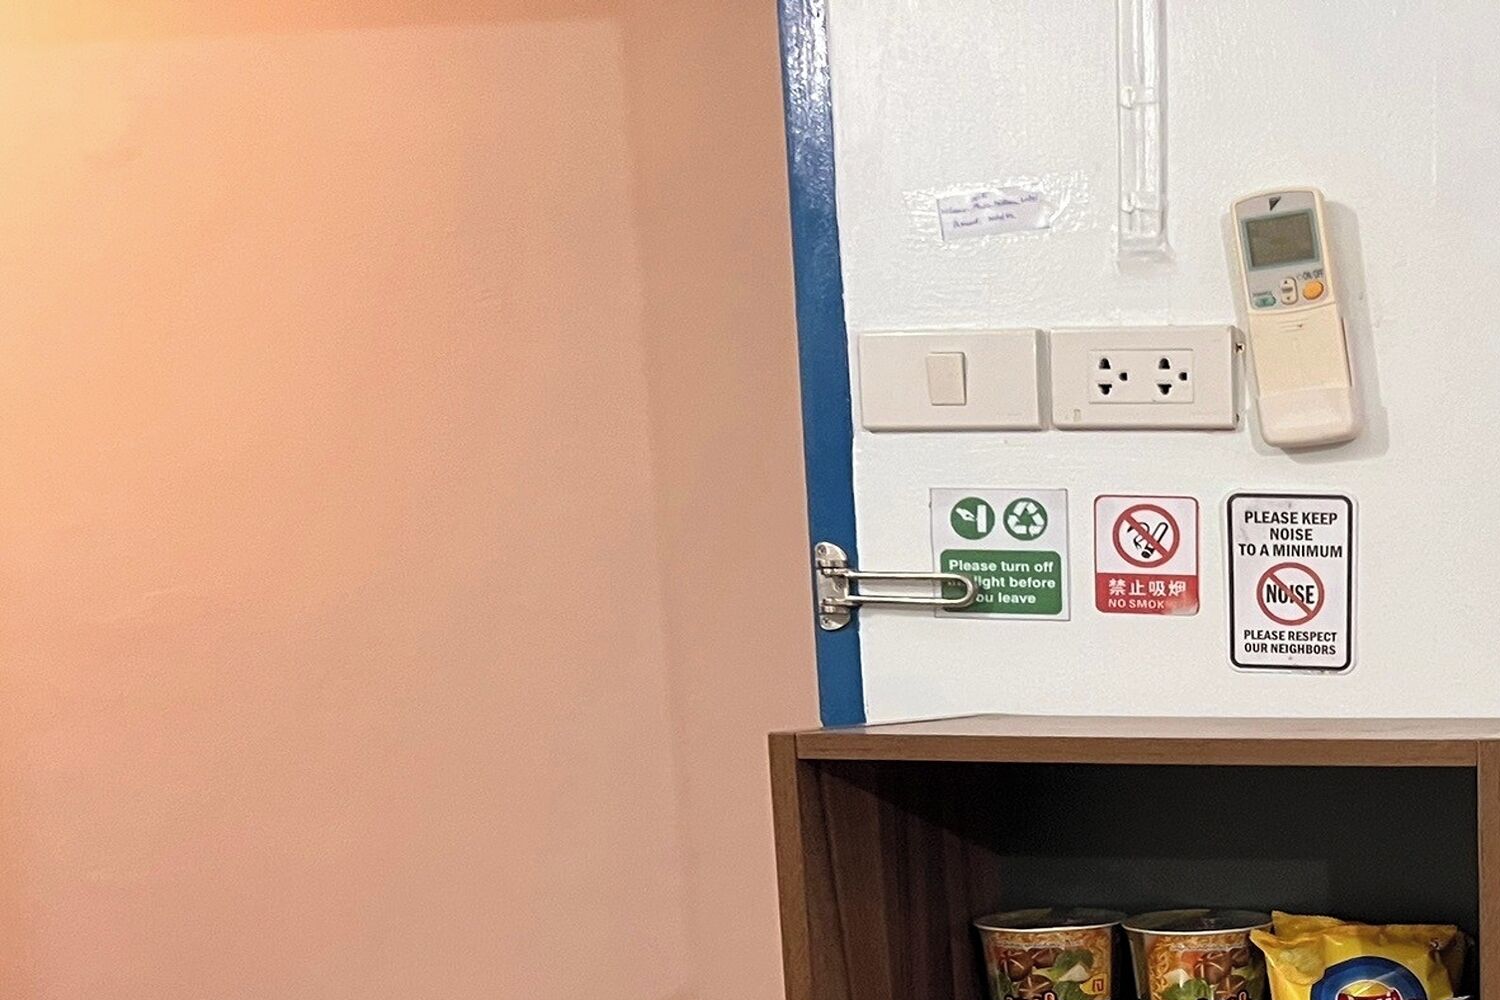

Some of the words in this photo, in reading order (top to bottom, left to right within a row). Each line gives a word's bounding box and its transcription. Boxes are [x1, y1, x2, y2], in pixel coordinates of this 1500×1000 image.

[1244, 511, 1299, 525] PLEASE
[1302, 512, 1338, 525] KEEP
[1270, 528, 1314, 541] NOISE
[1238, 543, 1257, 556] TO
[1259, 544, 1270, 557] A
[1273, 544, 1343, 558] MINIMUM
[948, 560, 997, 572] Please
[1001, 561, 1030, 573] turn
[1034, 561, 1054, 573] off
[1009, 576, 1056, 589] before
[1108, 578, 1187, 597] 禁止吸烟
[975, 593, 994, 604] ou
[998, 592, 1037, 604] leave
[1266, 584, 1315, 605] NOISE
[1108, 598, 1127, 608] NO
[1243, 629, 1286, 641] PLEASE
[1287, 630, 1337, 642] RESPECT
[1244, 643, 1268, 654] OUR
[1270, 643, 1336, 655] NEIGHBORS
